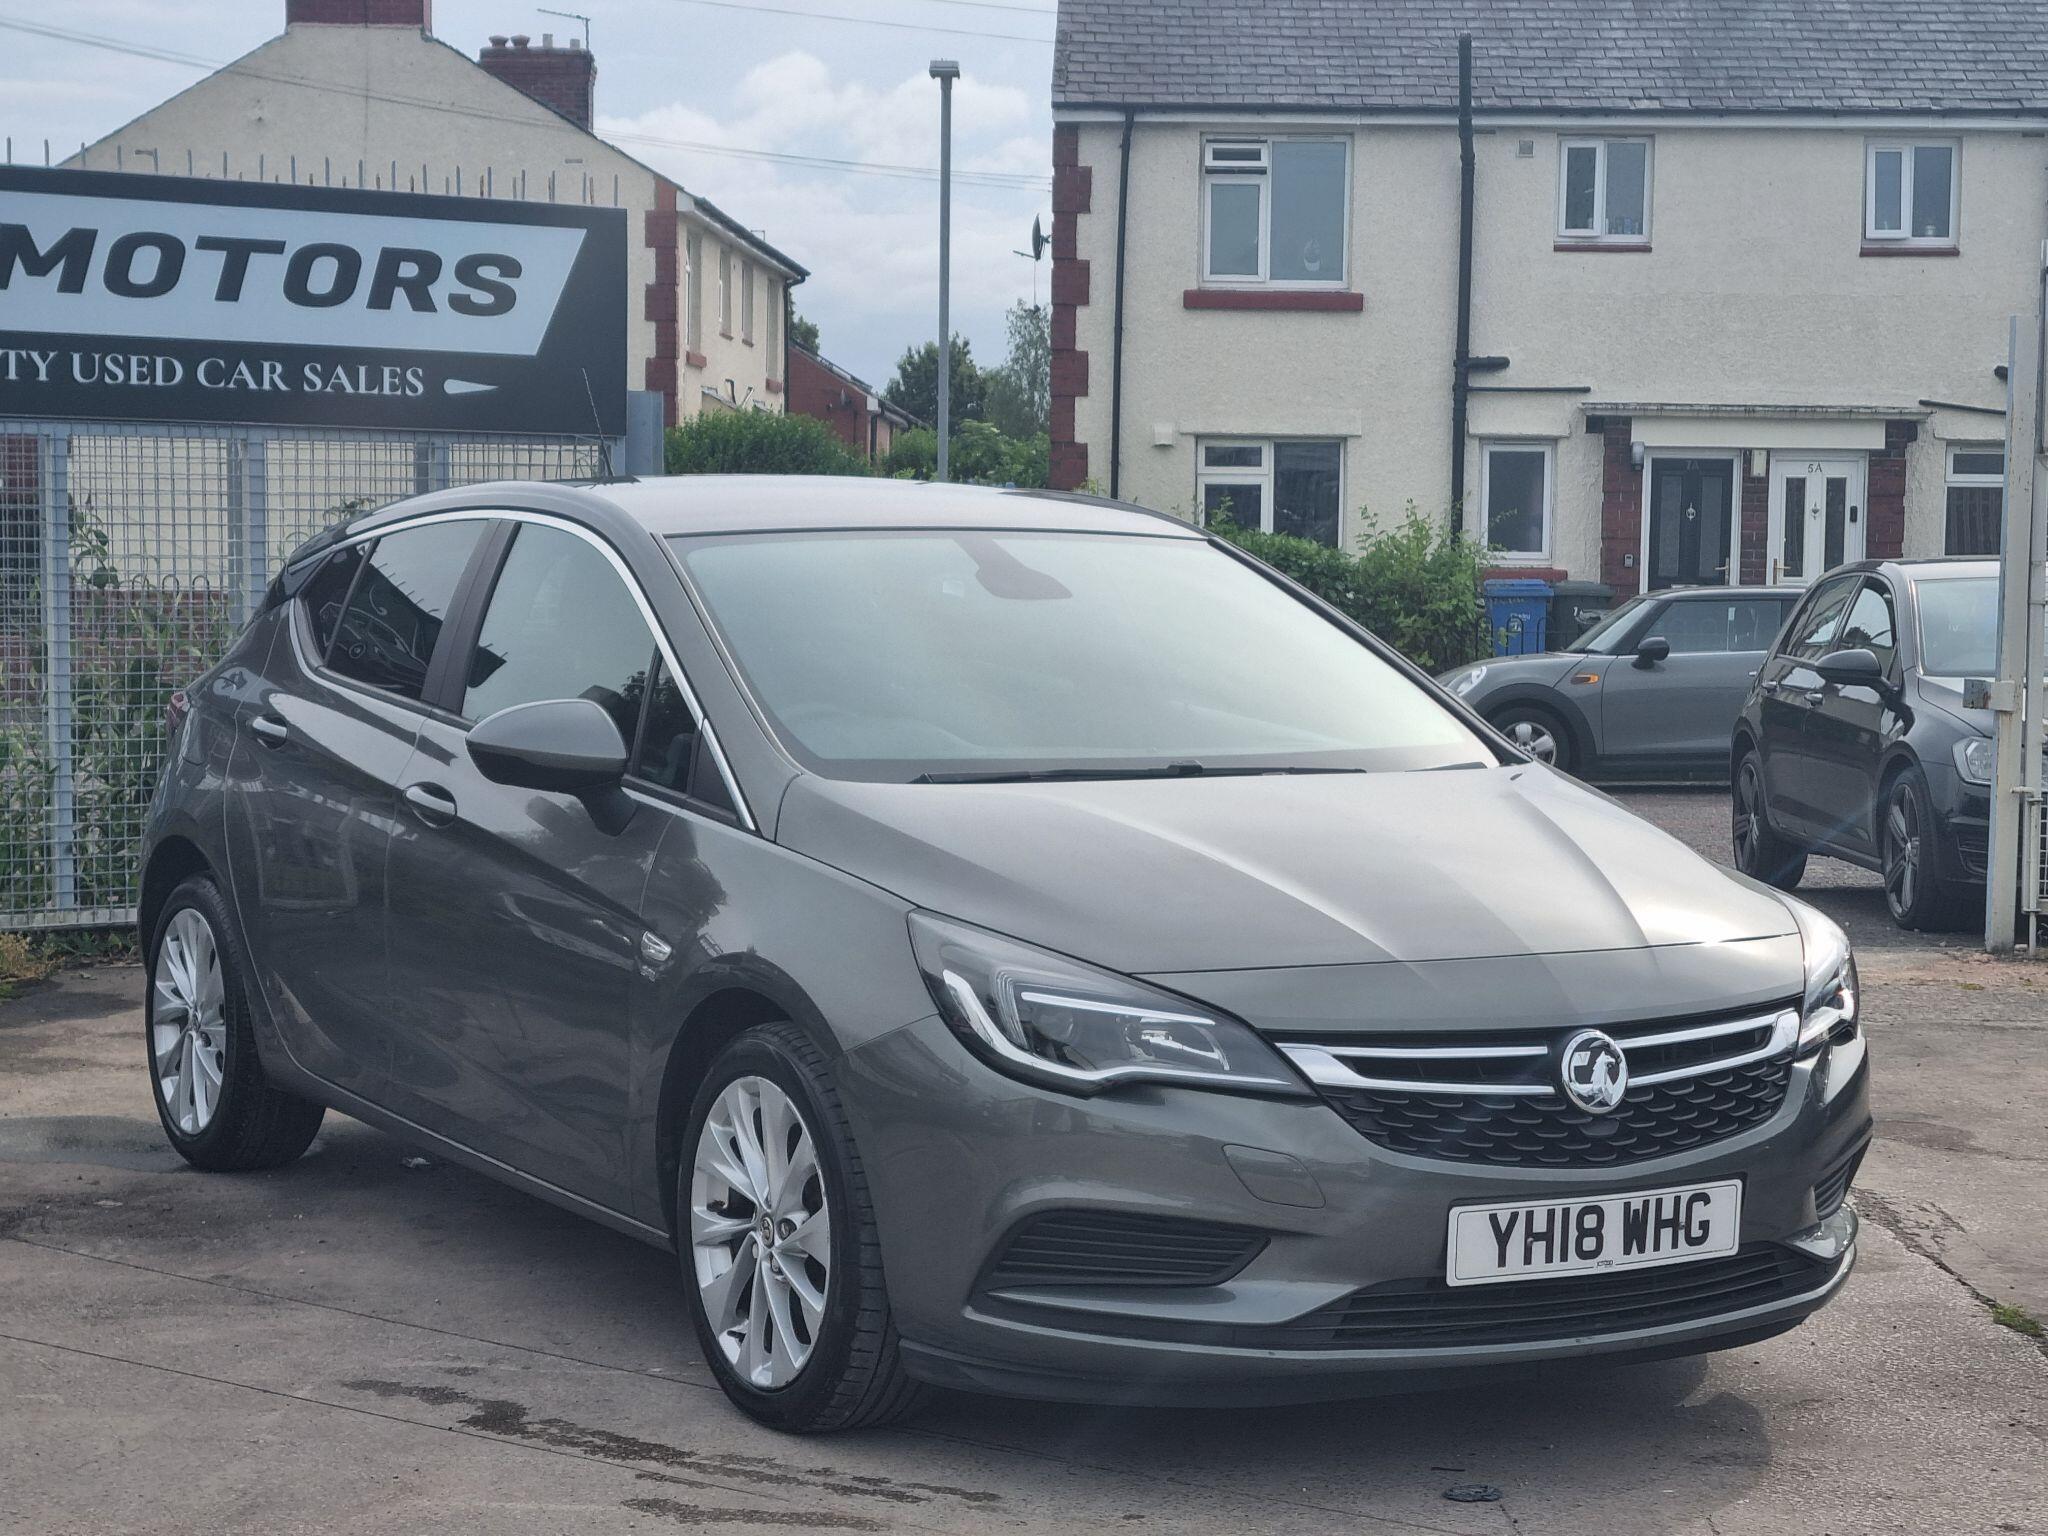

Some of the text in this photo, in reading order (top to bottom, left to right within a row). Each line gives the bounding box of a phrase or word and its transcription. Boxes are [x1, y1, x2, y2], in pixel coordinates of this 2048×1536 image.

[0, 223, 523, 317] MOTORS
[0, 349, 425, 396] TY USED CAR SALES
[1807, 461, 1823, 474] 5A
[1489, 1191, 1712, 1269] YH18 WHG
